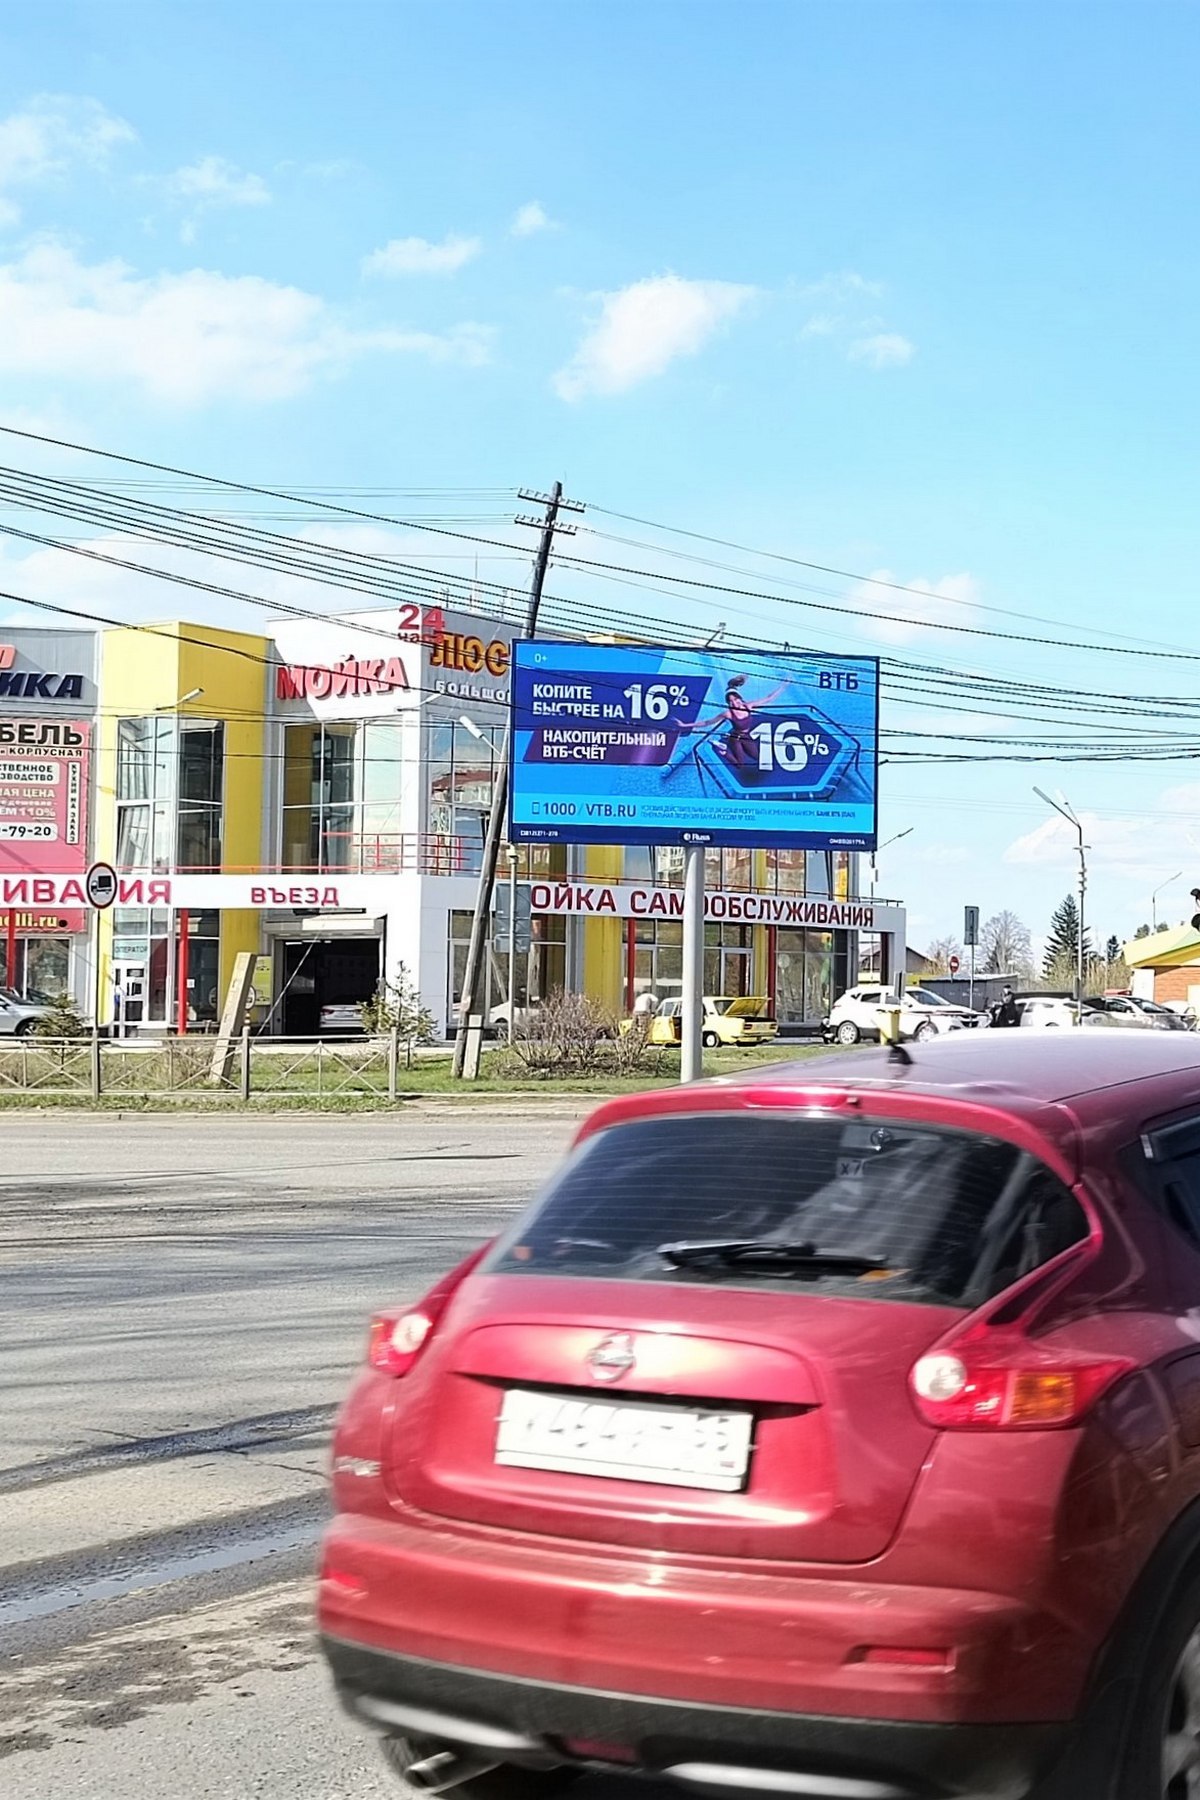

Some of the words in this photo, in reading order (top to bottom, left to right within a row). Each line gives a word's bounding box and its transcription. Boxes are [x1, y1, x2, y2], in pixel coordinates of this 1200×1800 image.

[398, 604, 445, 630] 24
[429, 631, 511, 677] ЛЮС
[276, 655, 411, 702] МОЙКА
[819, 671, 859, 690] ВТБ
[532, 684, 592, 700] КОПИТЕ
[532, 701, 600, 717] БЫСТРЕЕ
[602, 704, 625, 718] НА
[543, 729, 666, 746] НАКОПИТЕЛЬНЫЙ
[9, 747, 82, 756] КОРПУСНАЯ
[543, 744, 607, 760] ВТБ-СЧЁТ
[0, 763, 53, 773] ТВЕННОЕ
[23, 788, 55, 798] ЦЕНА
[543, 802, 576, 815] 1000
[586, 803, 637, 817] VTB.RU
[3, 879, 172, 905] ИВАИЯ
[251, 887, 339, 906] ВЪЕЗД
[531, 882, 616, 912] ОЙКА
[630, 890, 874, 928] САМОБСЛУЖИВАНИЯ
